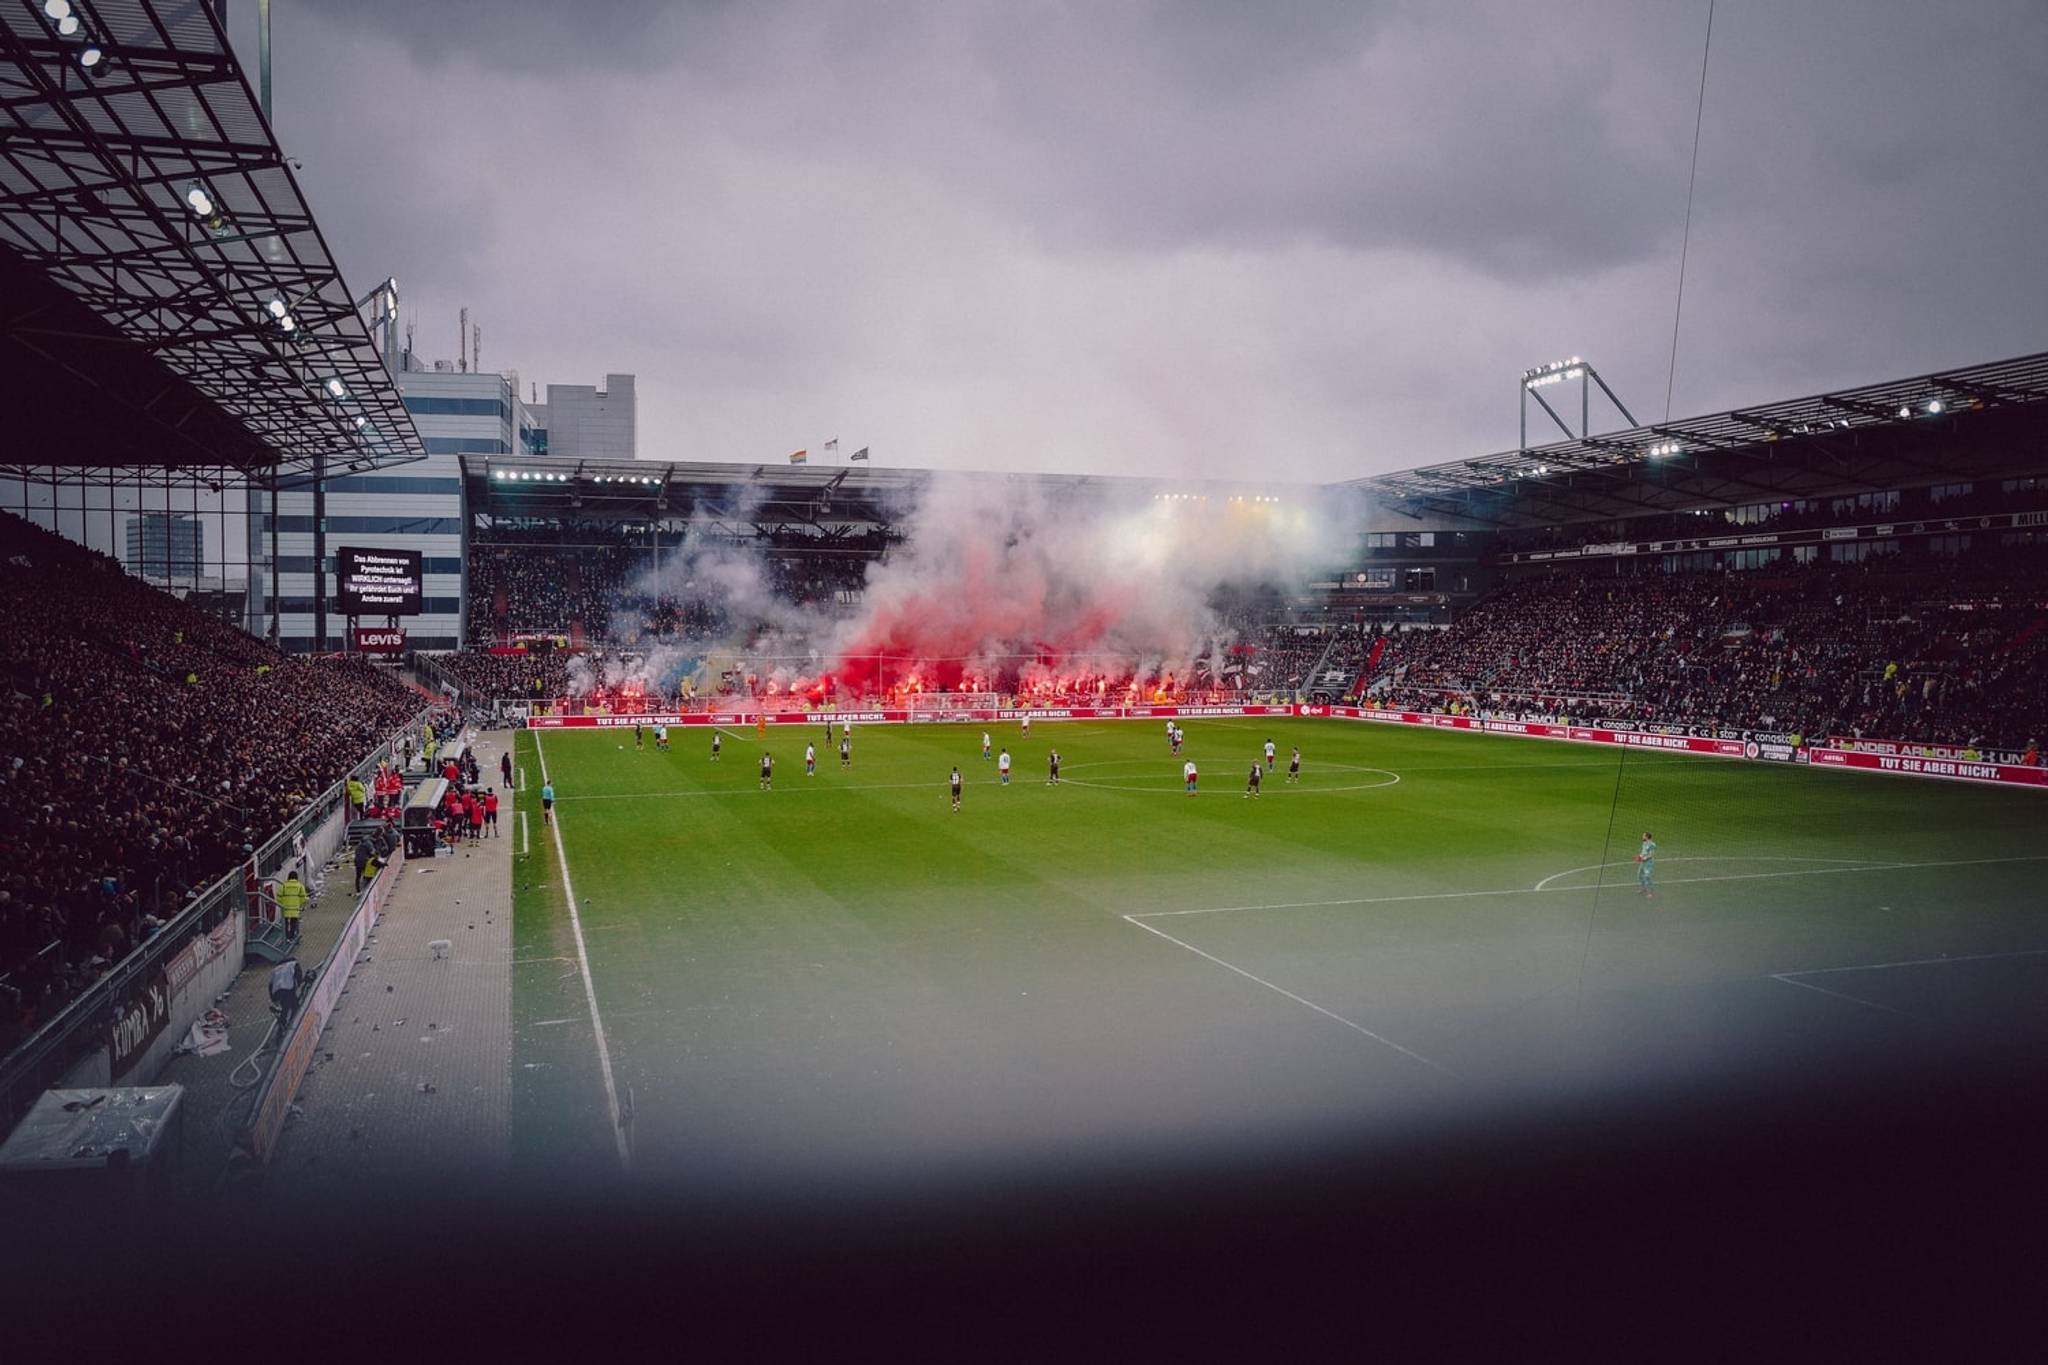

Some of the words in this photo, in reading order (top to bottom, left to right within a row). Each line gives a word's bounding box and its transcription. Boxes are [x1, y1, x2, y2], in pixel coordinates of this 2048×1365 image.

[2018, 512, 2048, 525] MILL
[361, 565, 394, 574] Pyrotechnik
[352, 574, 382, 583] WIRKLICH
[1614, 733, 1627, 743] TUT
[1628, 734, 1641, 744] SIE
[1642, 735, 1662, 746] ABER
[1663, 737, 1690, 749] NICHT.
[1755, 733, 1792, 744] congsta
[1879, 757, 1900, 769] TUT
[1902, 759, 1921, 771] SIE
[1923, 760, 1955, 774] ABER
[1958, 763, 2000, 779] NICHT.
